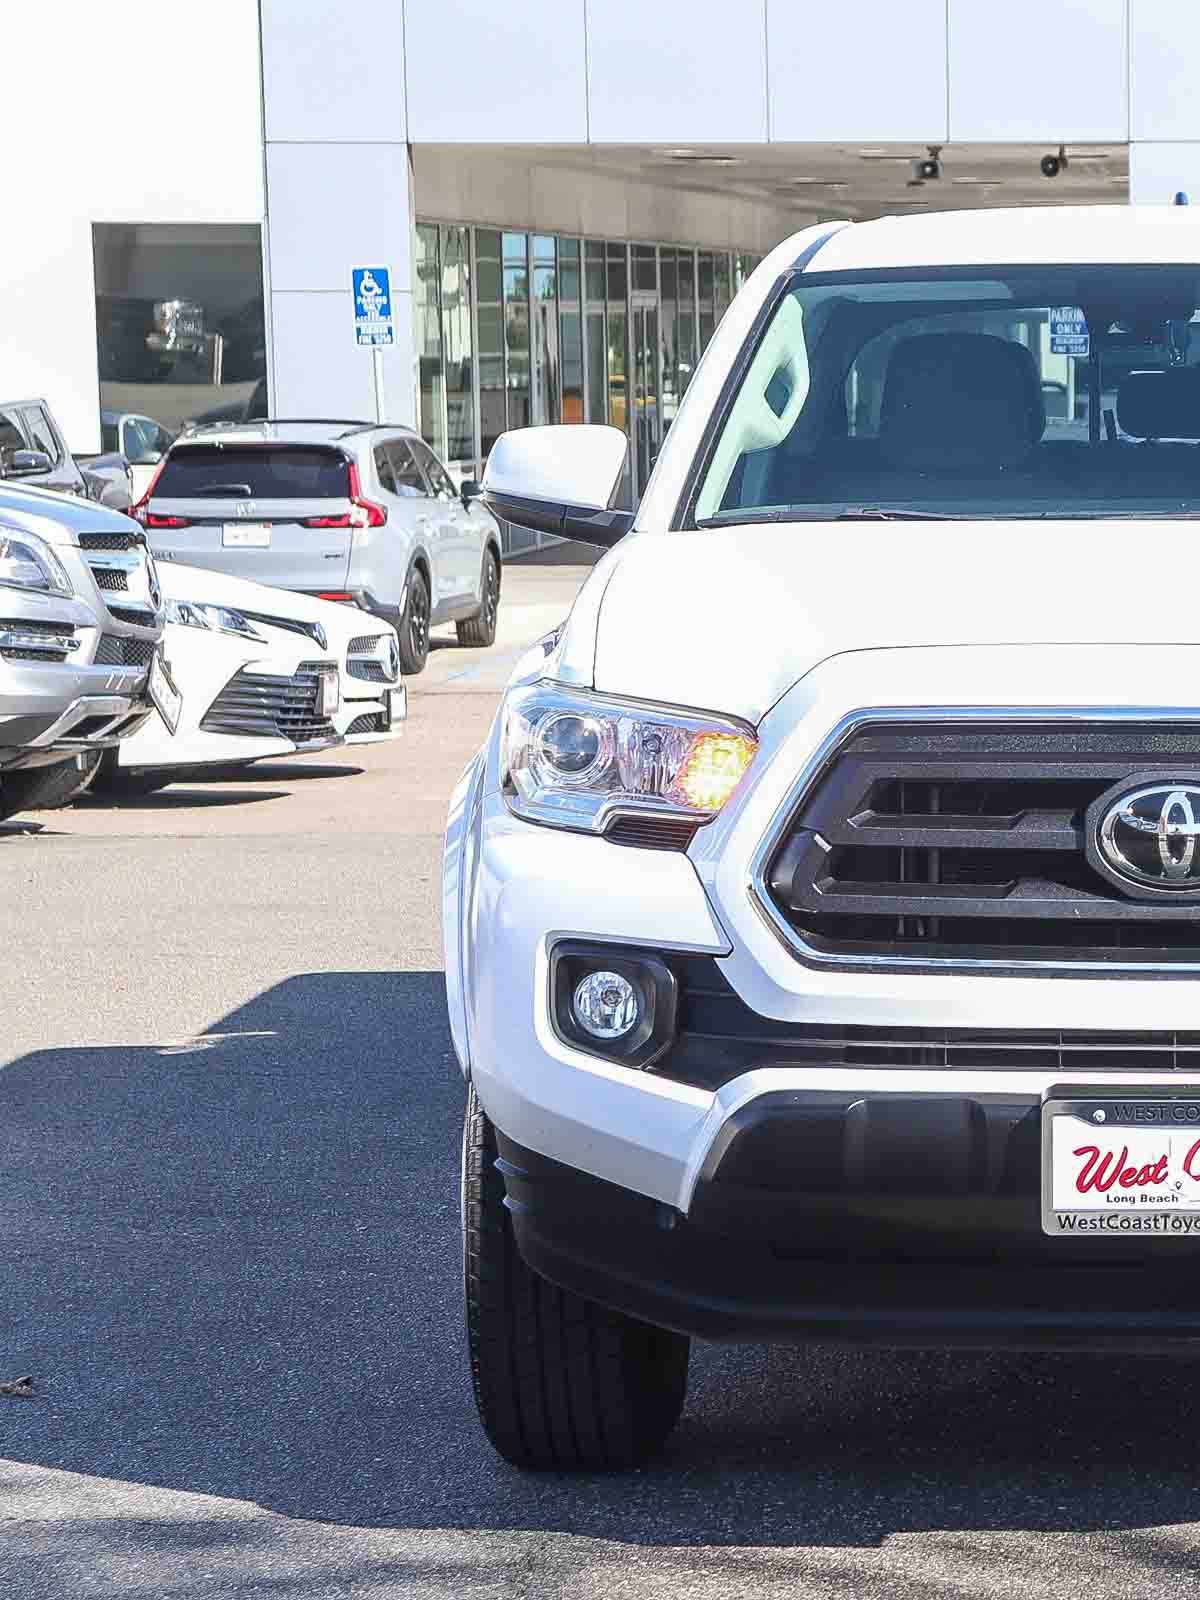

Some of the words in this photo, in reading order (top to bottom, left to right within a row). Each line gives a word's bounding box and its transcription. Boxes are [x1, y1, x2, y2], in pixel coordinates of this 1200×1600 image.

[1051, 308, 1087, 321] PARKIN
[1056, 323, 1082, 334] ONLY
[1113, 1105, 1168, 1121] WEST
[1072, 1145, 1169, 1193] West
[1106, 1194, 1136, 1204] Long
[1140, 1194, 1179, 1203] Beach
